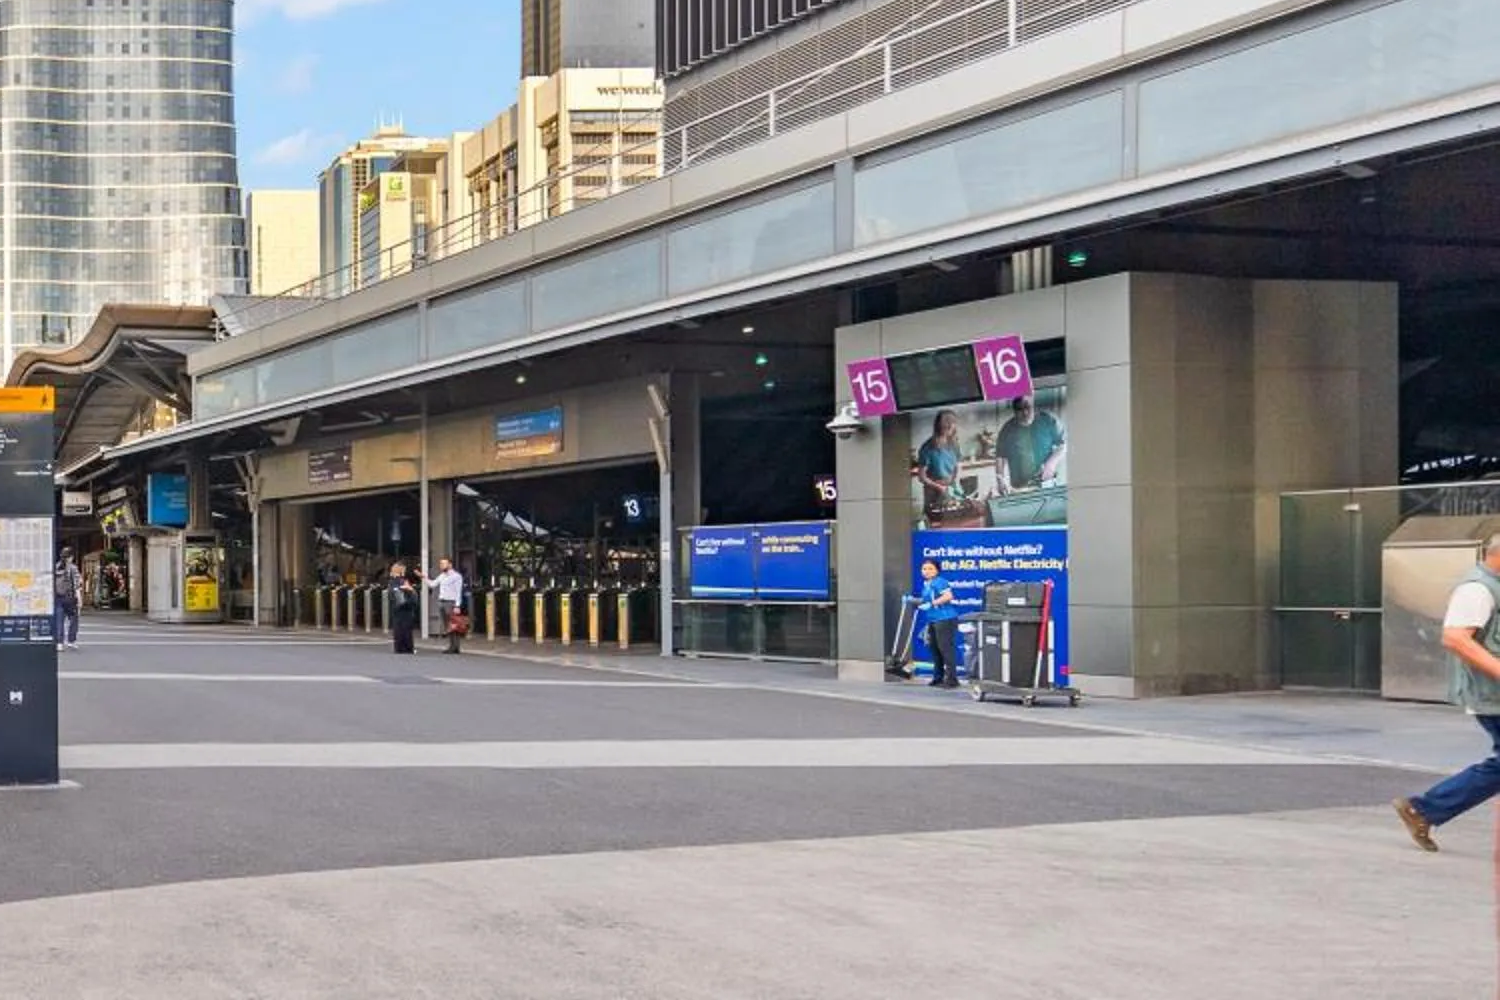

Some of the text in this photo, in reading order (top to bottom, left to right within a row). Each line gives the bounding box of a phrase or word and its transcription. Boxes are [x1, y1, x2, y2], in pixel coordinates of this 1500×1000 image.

[980, 348, 1022, 386] 16
[852, 370, 888, 404] 15
[815, 480, 836, 500] 15
[624, 499, 639, 517] 13
[923, 544, 1043, 557] Can't live without Netflix?
[942, 560, 957, 570] the
[979, 559, 1011, 570] Netflix
[1013, 558, 1063, 571] Electricity
